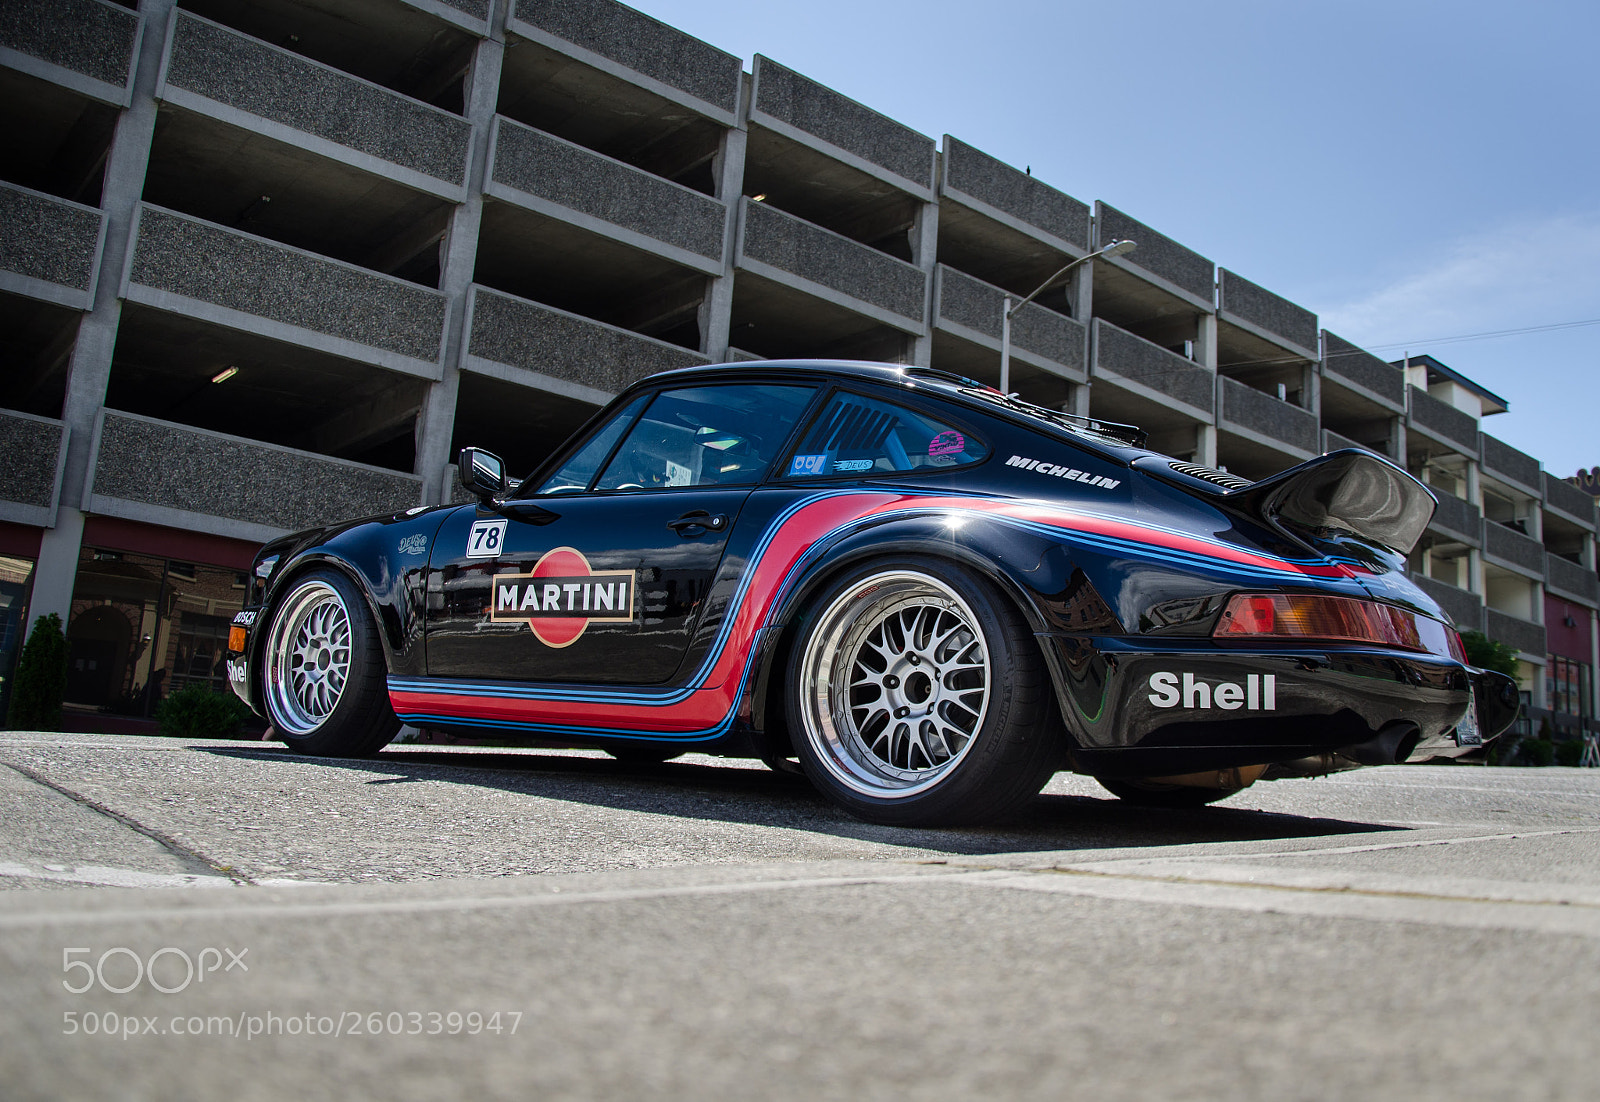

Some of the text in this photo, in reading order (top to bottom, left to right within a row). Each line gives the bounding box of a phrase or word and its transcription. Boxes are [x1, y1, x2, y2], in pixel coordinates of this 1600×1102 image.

[1005, 455, 1120, 490] MICHELIN
[474, 527, 500, 549] 78
[498, 582, 626, 611] MARTINI
[1148, 671, 1275, 710] Shell
